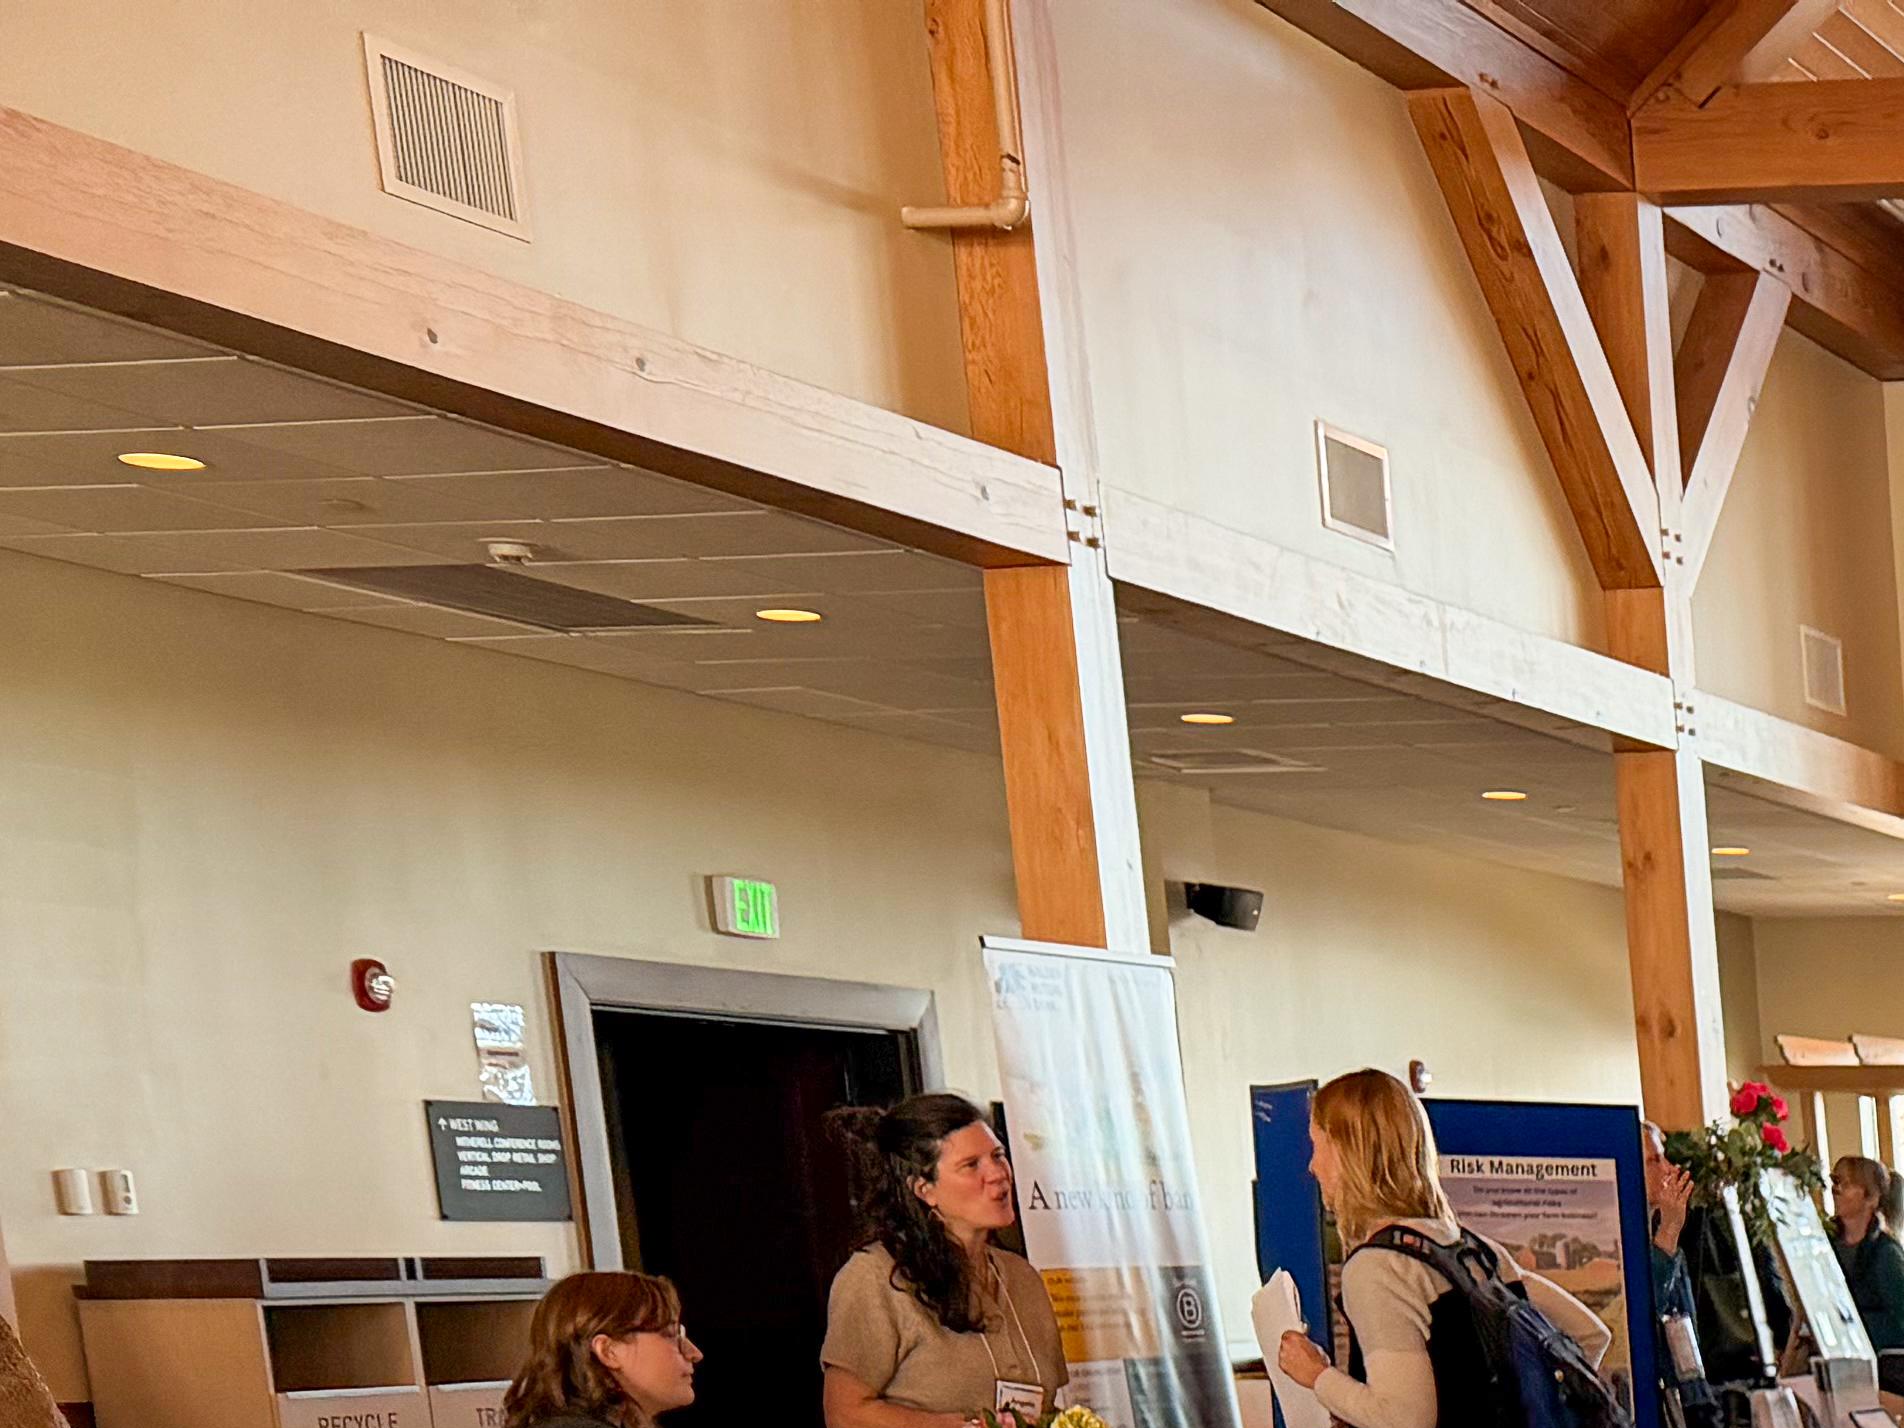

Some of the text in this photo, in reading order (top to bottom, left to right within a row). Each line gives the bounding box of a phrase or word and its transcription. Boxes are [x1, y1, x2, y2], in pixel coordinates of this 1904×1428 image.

[733, 879, 774, 935] EXIT
[449, 1118, 474, 1131] WEST
[1450, 1158, 1598, 1182] Risk Management
[1028, 1181, 1052, 1211] A
